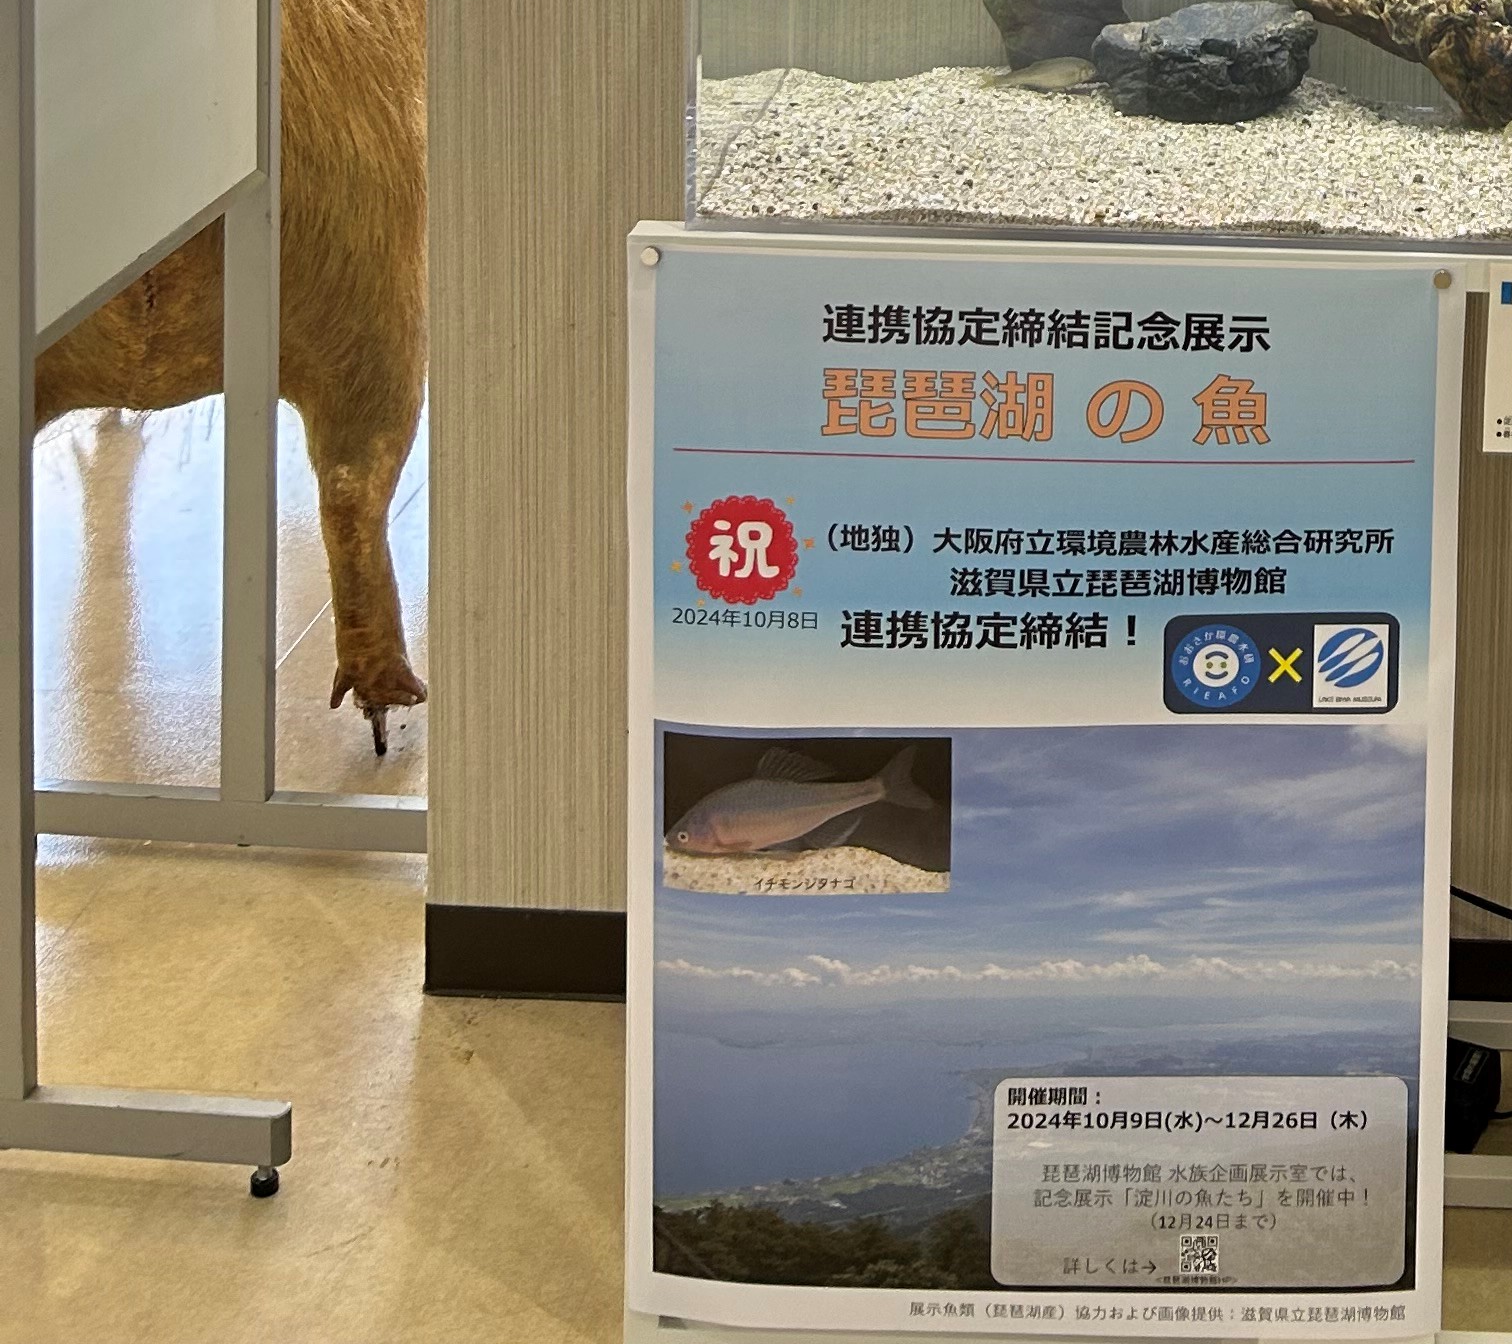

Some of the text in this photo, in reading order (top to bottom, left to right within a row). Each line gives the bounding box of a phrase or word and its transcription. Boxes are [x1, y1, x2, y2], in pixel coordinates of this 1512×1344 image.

[821, 304, 1272, 353] 連携協定締結記念展示
[708, 519, 780, 578] 祝
[949, 566, 1288, 597] 滋賀県立琵琶湖博物館
[671, 607, 819, 631] 2024年10月8日
[840, 611, 1139, 650] 連携協定締結！
[753, 877, 855, 891] イチモンジタナゴ
[1007, 1086, 1101, 1106] 開催期間：
